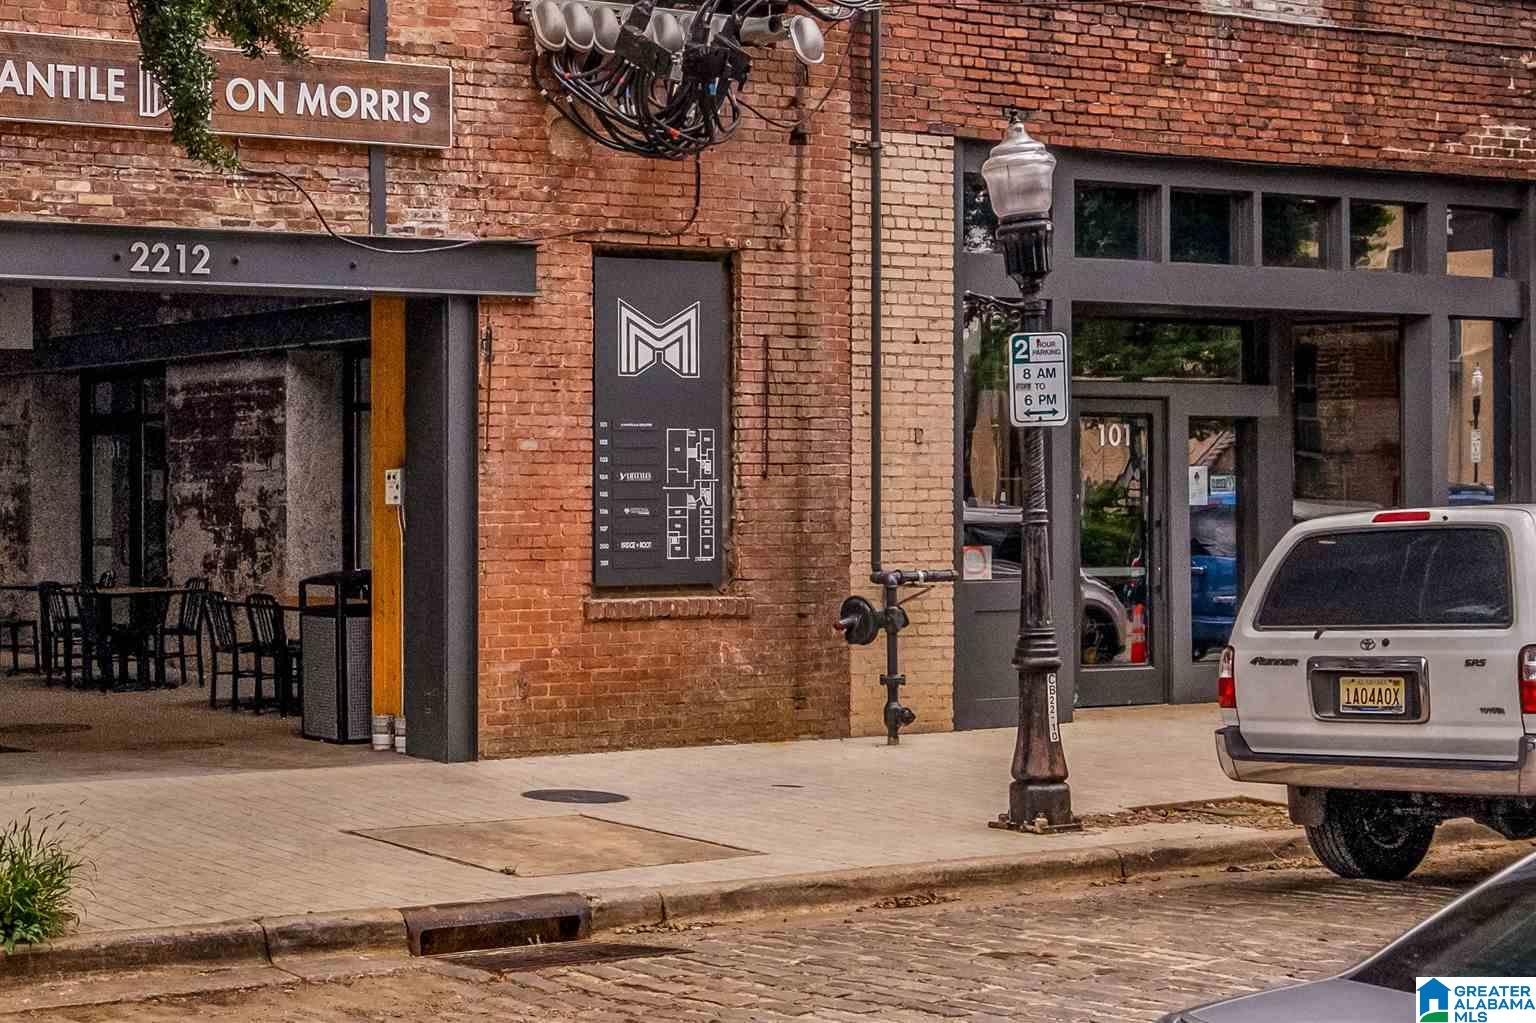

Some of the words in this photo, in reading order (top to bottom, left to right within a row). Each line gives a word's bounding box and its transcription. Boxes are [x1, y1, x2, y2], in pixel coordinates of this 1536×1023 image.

[225, 77, 285, 114] ON
[296, 82, 431, 124] MORRIS
[129, 241, 211, 274] 2212
[1015, 339, 1029, 360] 2
[1032, 348, 1062, 356] PARKING
[1023, 367, 1032, 380] 8
[1037, 367, 1057, 379] AM
[1035, 382, 1046, 391] TO
[1024, 394, 1033, 406] 6
[1038, 393, 1057, 406] PM
[1098, 423, 1130, 446] 101
[1345, 687, 1400, 705] 1A04A0X
